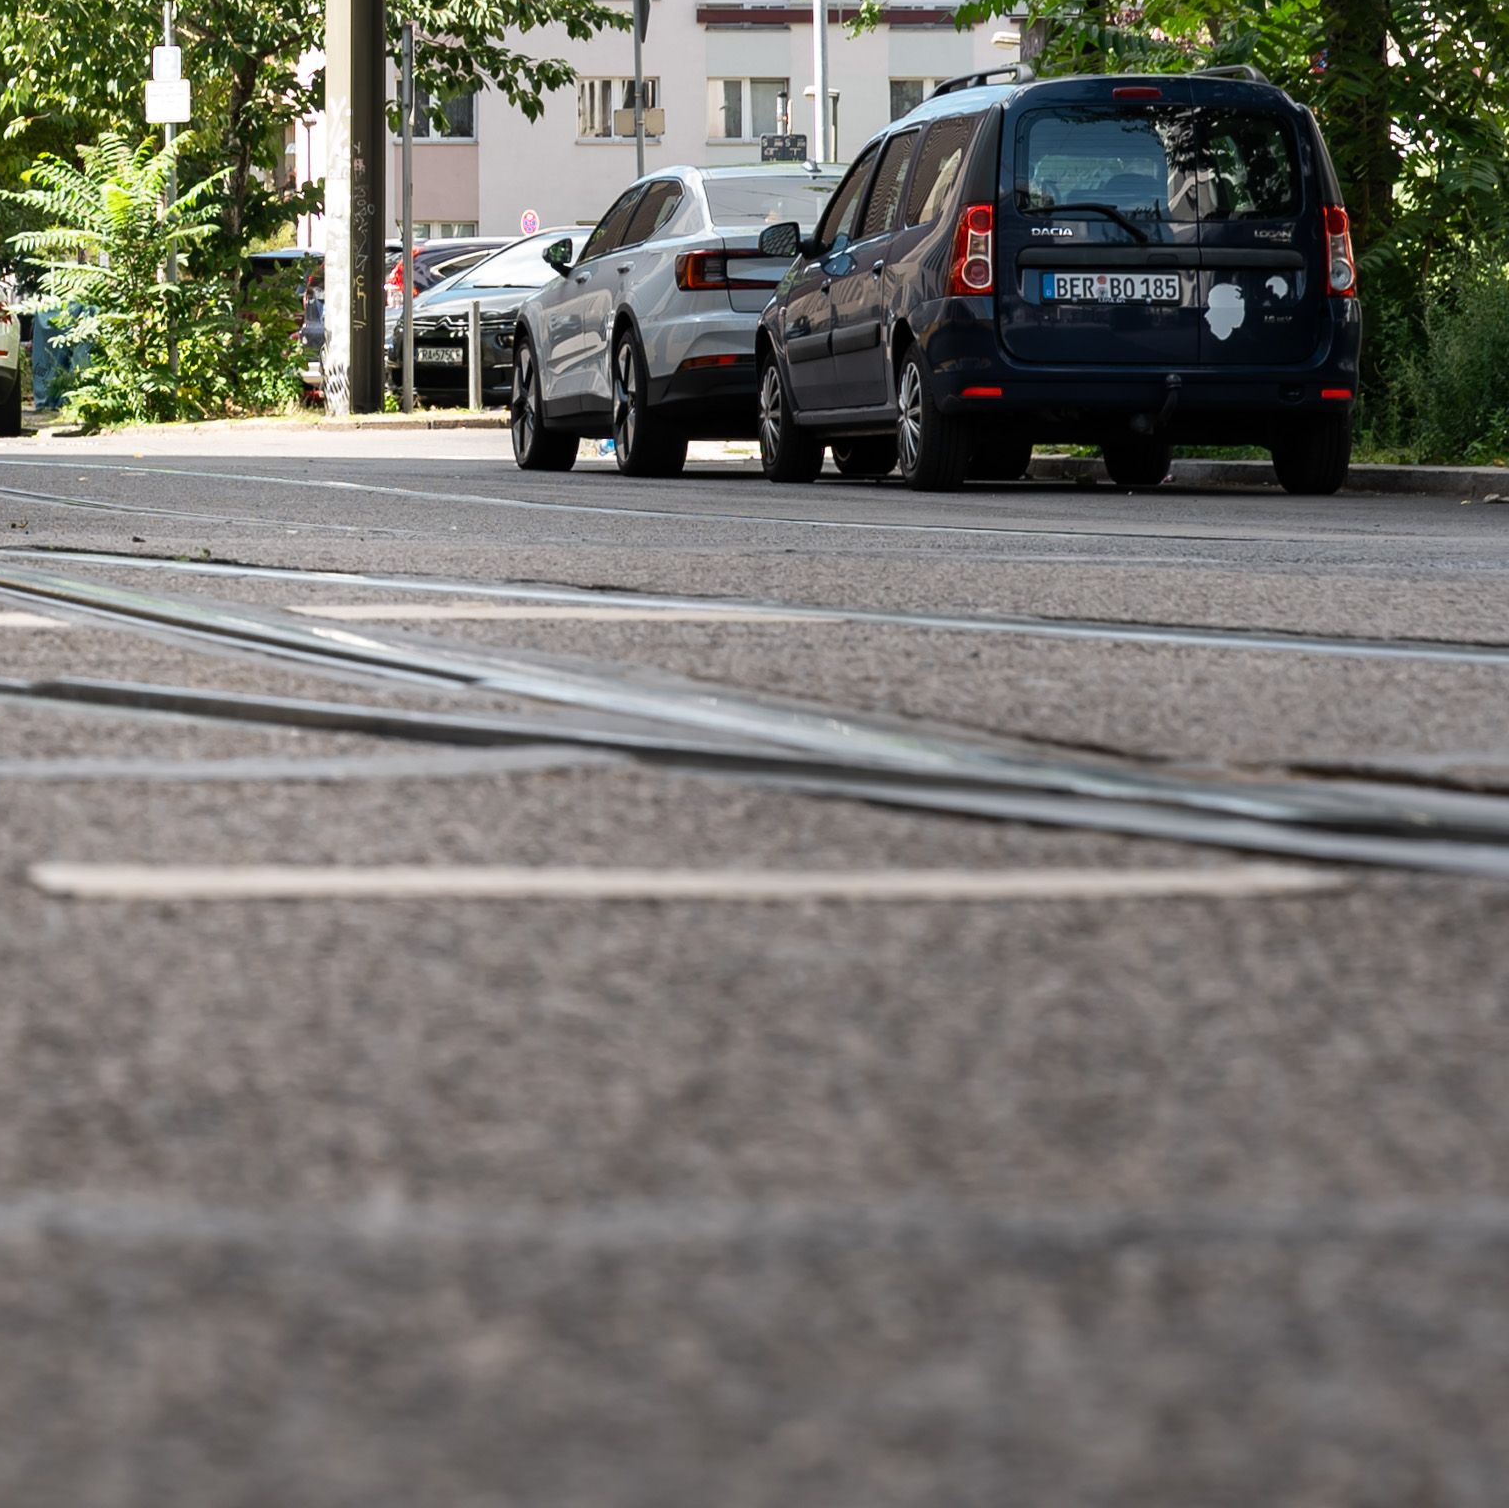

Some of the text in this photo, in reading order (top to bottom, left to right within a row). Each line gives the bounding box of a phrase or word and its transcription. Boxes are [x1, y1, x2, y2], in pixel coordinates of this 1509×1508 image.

[1031, 227, 1073, 237] DACIA
[1254, 229, 1292, 239] LOGAN
[1056, 277, 1094, 298] BER
[1110, 277, 1135, 298] BO
[1140, 277, 1178, 299] 185
